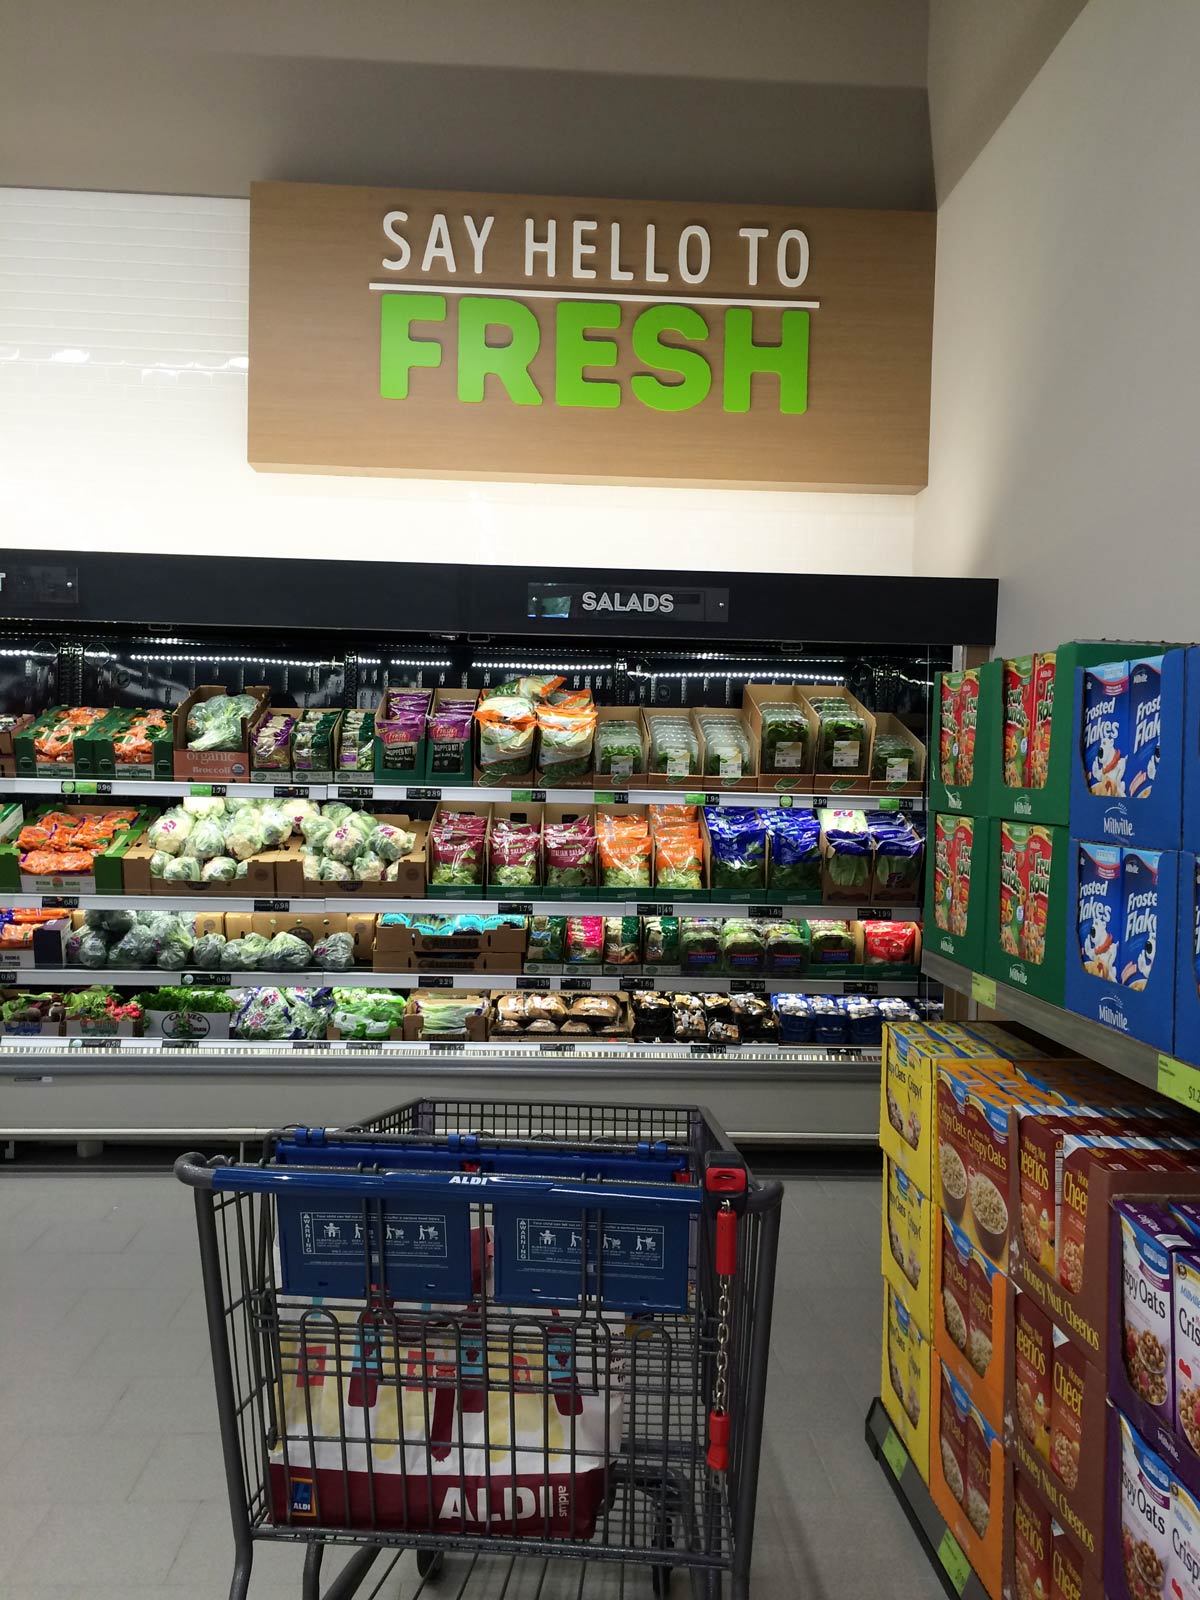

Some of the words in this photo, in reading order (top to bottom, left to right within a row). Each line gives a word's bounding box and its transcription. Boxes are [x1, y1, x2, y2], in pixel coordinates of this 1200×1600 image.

[382, 211, 495, 274] SAY
[525, 218, 711, 284] HELLO
[739, 228, 810, 288] TO
[380, 293, 810, 415] FRESH
[582, 591, 674, 613] SALADS
[186, 751, 235, 764] organic
[1104, 816, 1134, 836] Millville
[1099, 1004, 1129, 1031] Millville
[952, 1115, 967, 1140] Oats
[967, 1129, 987, 1161] Crispy
[987, 1143, 1007, 1170] Oats
[449, 1175, 488, 1185] ALDI
[303, 1219, 312, 1253] WARNING
[1023, 1258, 1046, 1304] Honey
[1047, 1282, 1063, 1317] Nut
[1064, 1300, 1099, 1351] Cheerios
[1140, 1279, 1166, 1319] Oats
[293, 1502, 311, 1511] ALDI
[438, 1485, 555, 1523] ALDI
[1041, 1469, 1059, 1508] Nut
[1059, 1494, 1094, 1552] Cheerios
[1137, 1488, 1166, 1535] Oats
